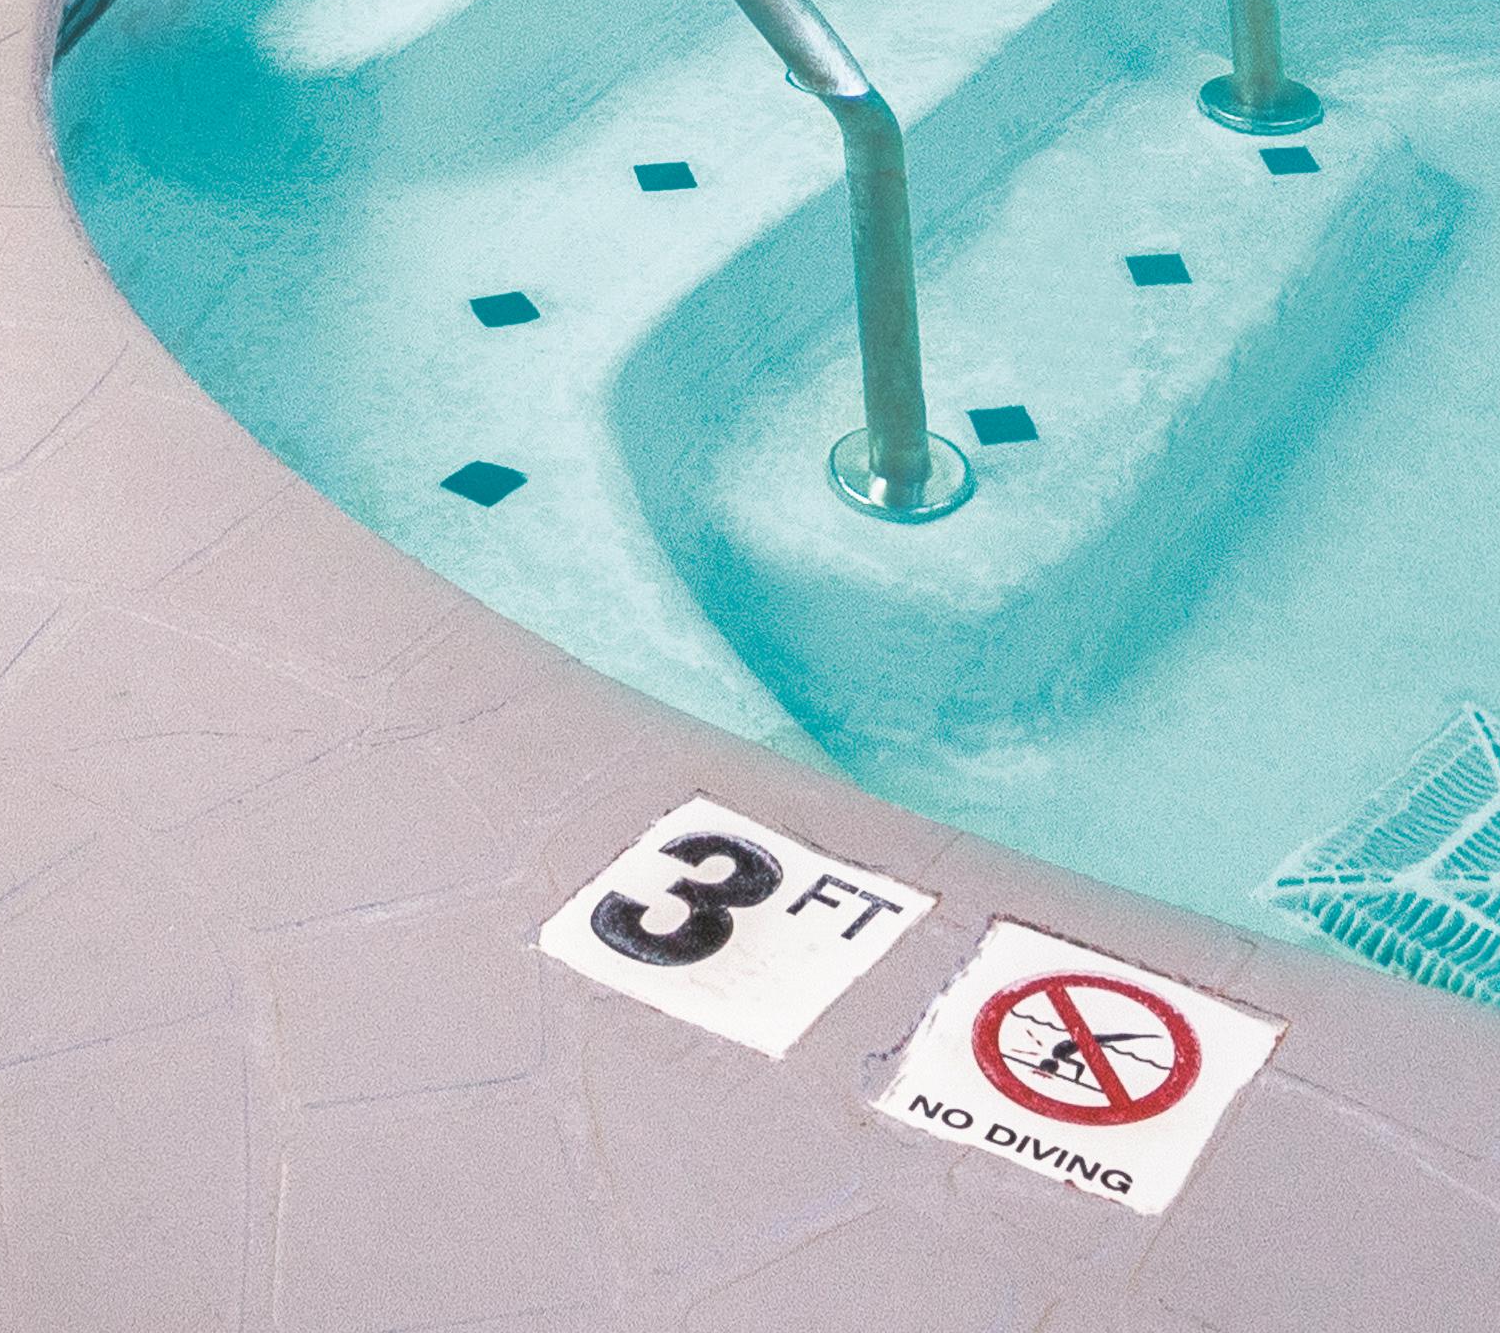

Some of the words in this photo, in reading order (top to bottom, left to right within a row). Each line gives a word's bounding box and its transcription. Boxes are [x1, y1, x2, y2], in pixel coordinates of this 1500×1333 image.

[590, 831, 783, 966] 3
[786, 873, 902, 940] FT
[909, 1094, 975, 1130] NO
[984, 1122, 1134, 1194] DIVING
